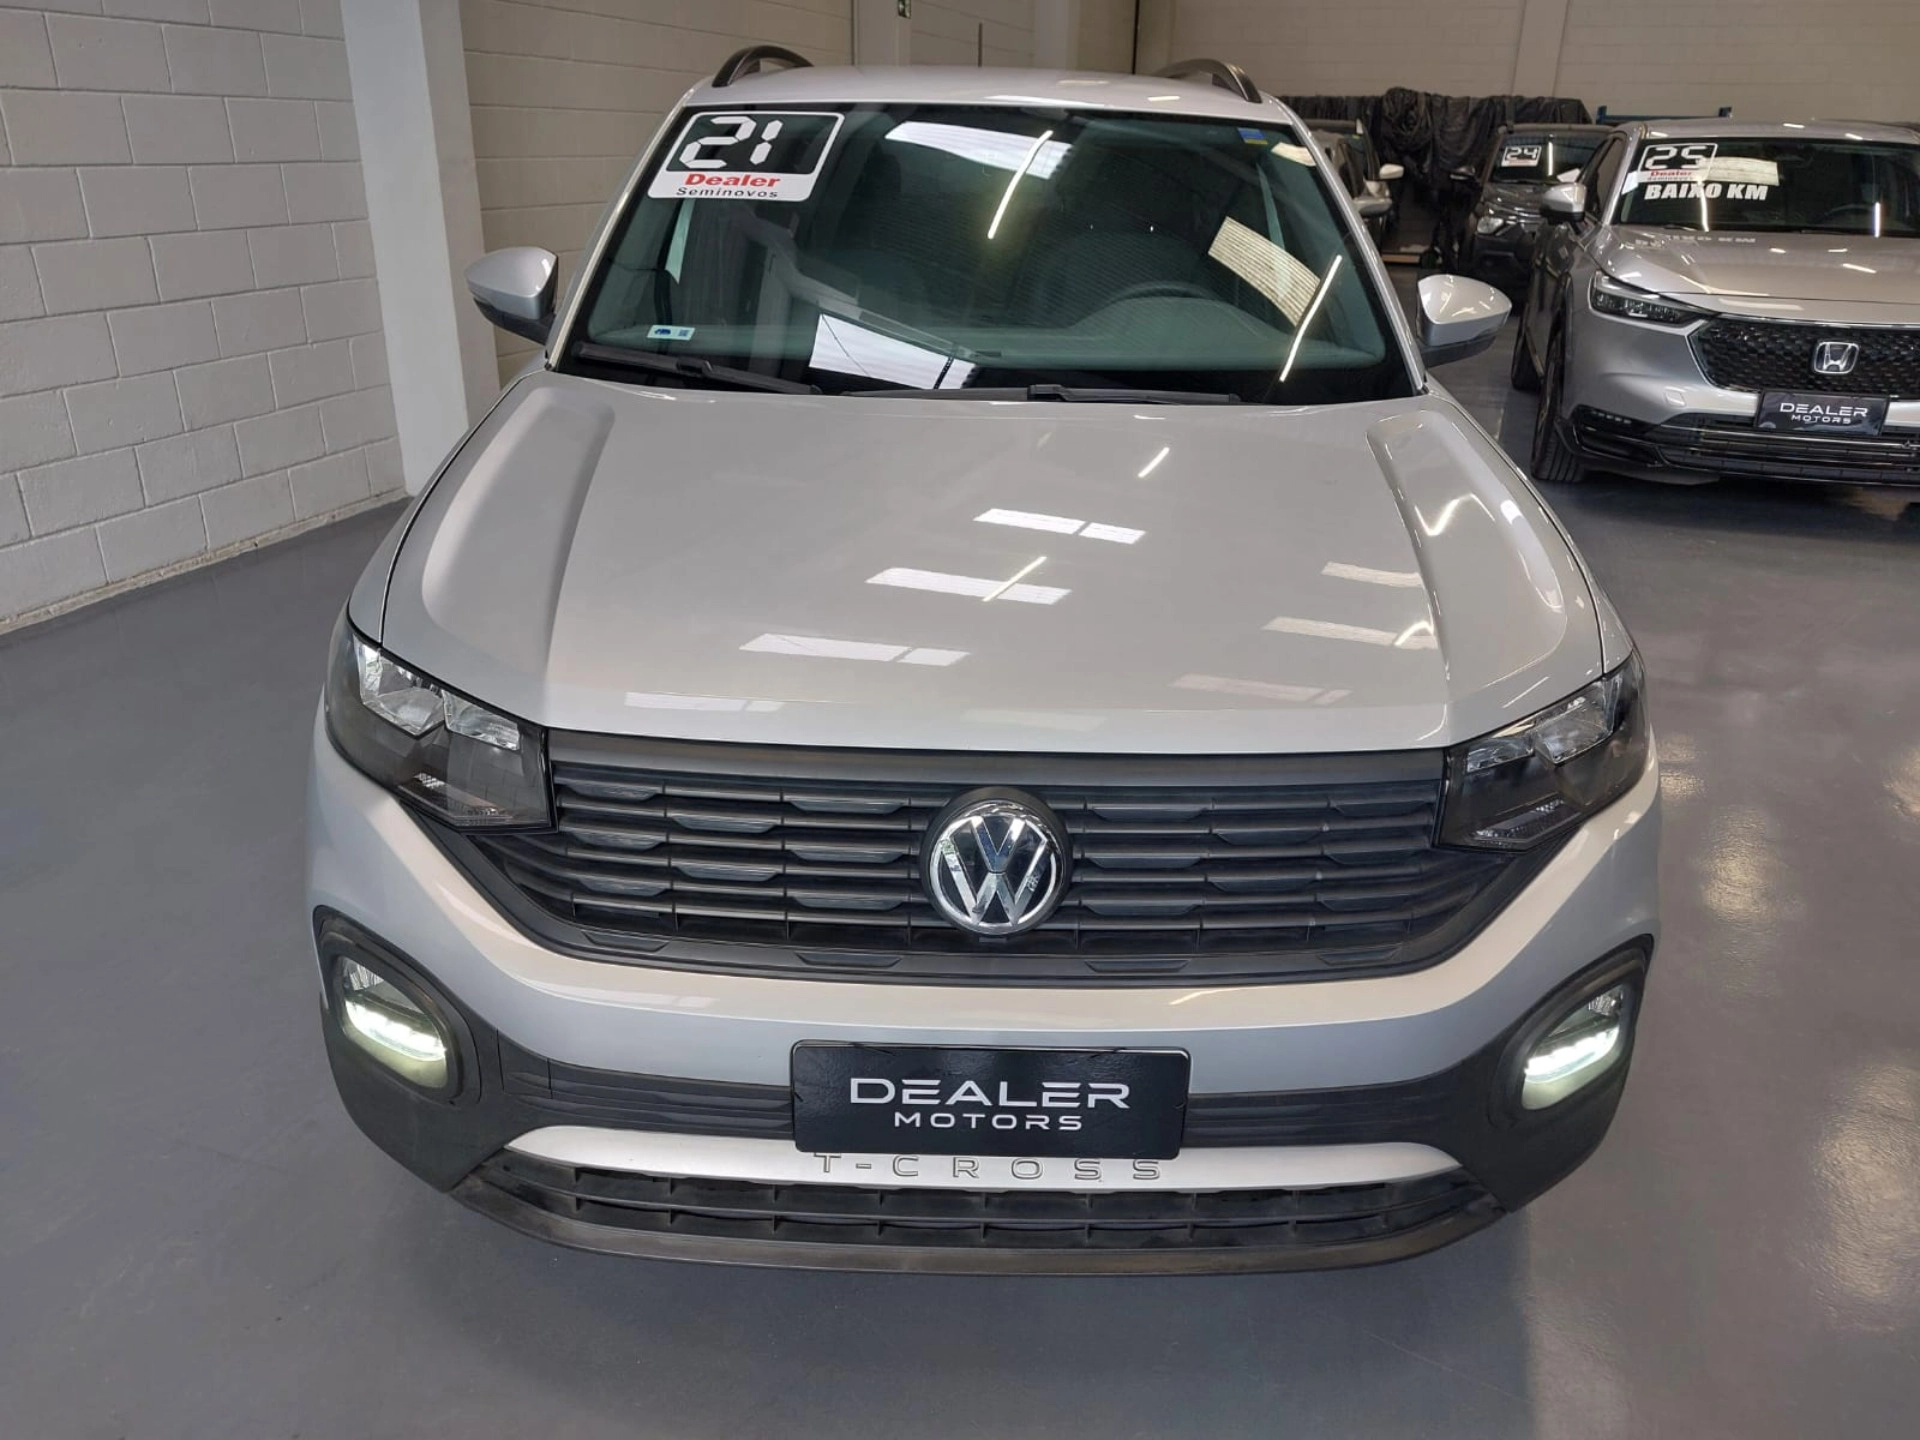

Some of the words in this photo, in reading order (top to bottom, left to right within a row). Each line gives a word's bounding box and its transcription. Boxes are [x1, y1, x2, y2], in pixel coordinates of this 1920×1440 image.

[680, 116, 783, 168] 21
[1506, 147, 1538, 160] 24
[1645, 146, 1708, 169] 25
[685, 173, 780, 187] Dealer
[676, 186, 778, 198] Seminovos
[1644, 183, 1723, 200] BAIXO
[1726, 185, 1769, 200] KM
[1780, 402, 1868, 417] DEALER
[1791, 415, 1852, 424] MOTORS
[850, 1077, 1130, 1109] DEALER
[894, 1112, 1082, 1130] MOTORS
[814, 1153, 1160, 1180] T-CROSS
